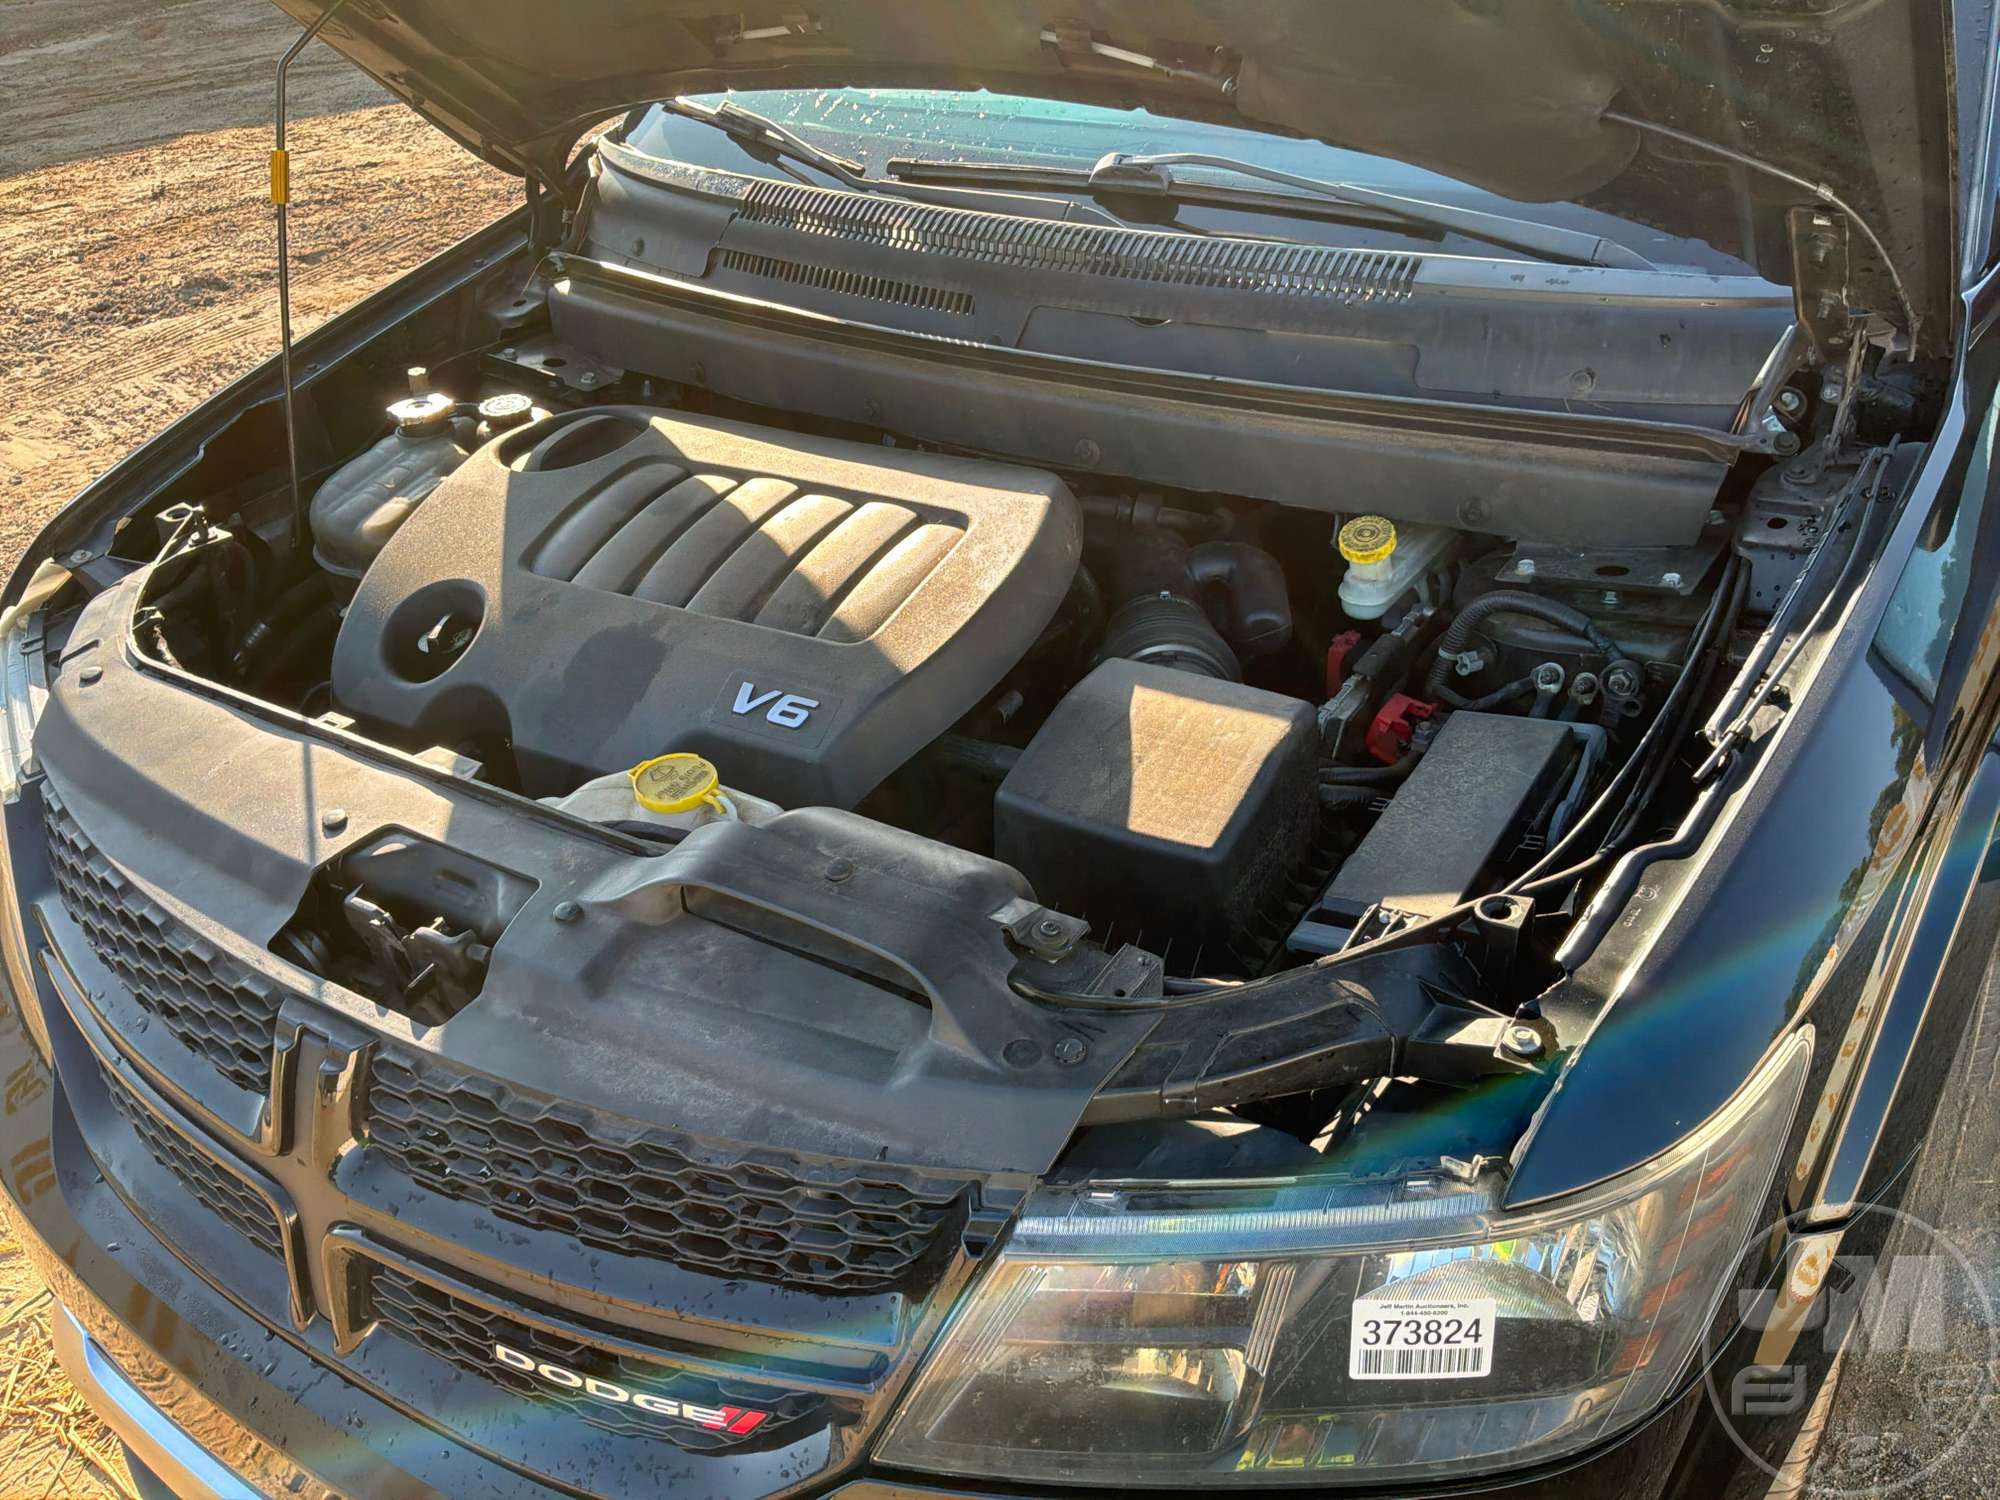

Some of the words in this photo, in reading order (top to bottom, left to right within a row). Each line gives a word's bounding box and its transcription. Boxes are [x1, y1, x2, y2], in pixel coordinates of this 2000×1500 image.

[732, 681, 821, 729] V6
[1362, 1317, 1482, 1346] 373824
[495, 1343, 728, 1428] DODGE
